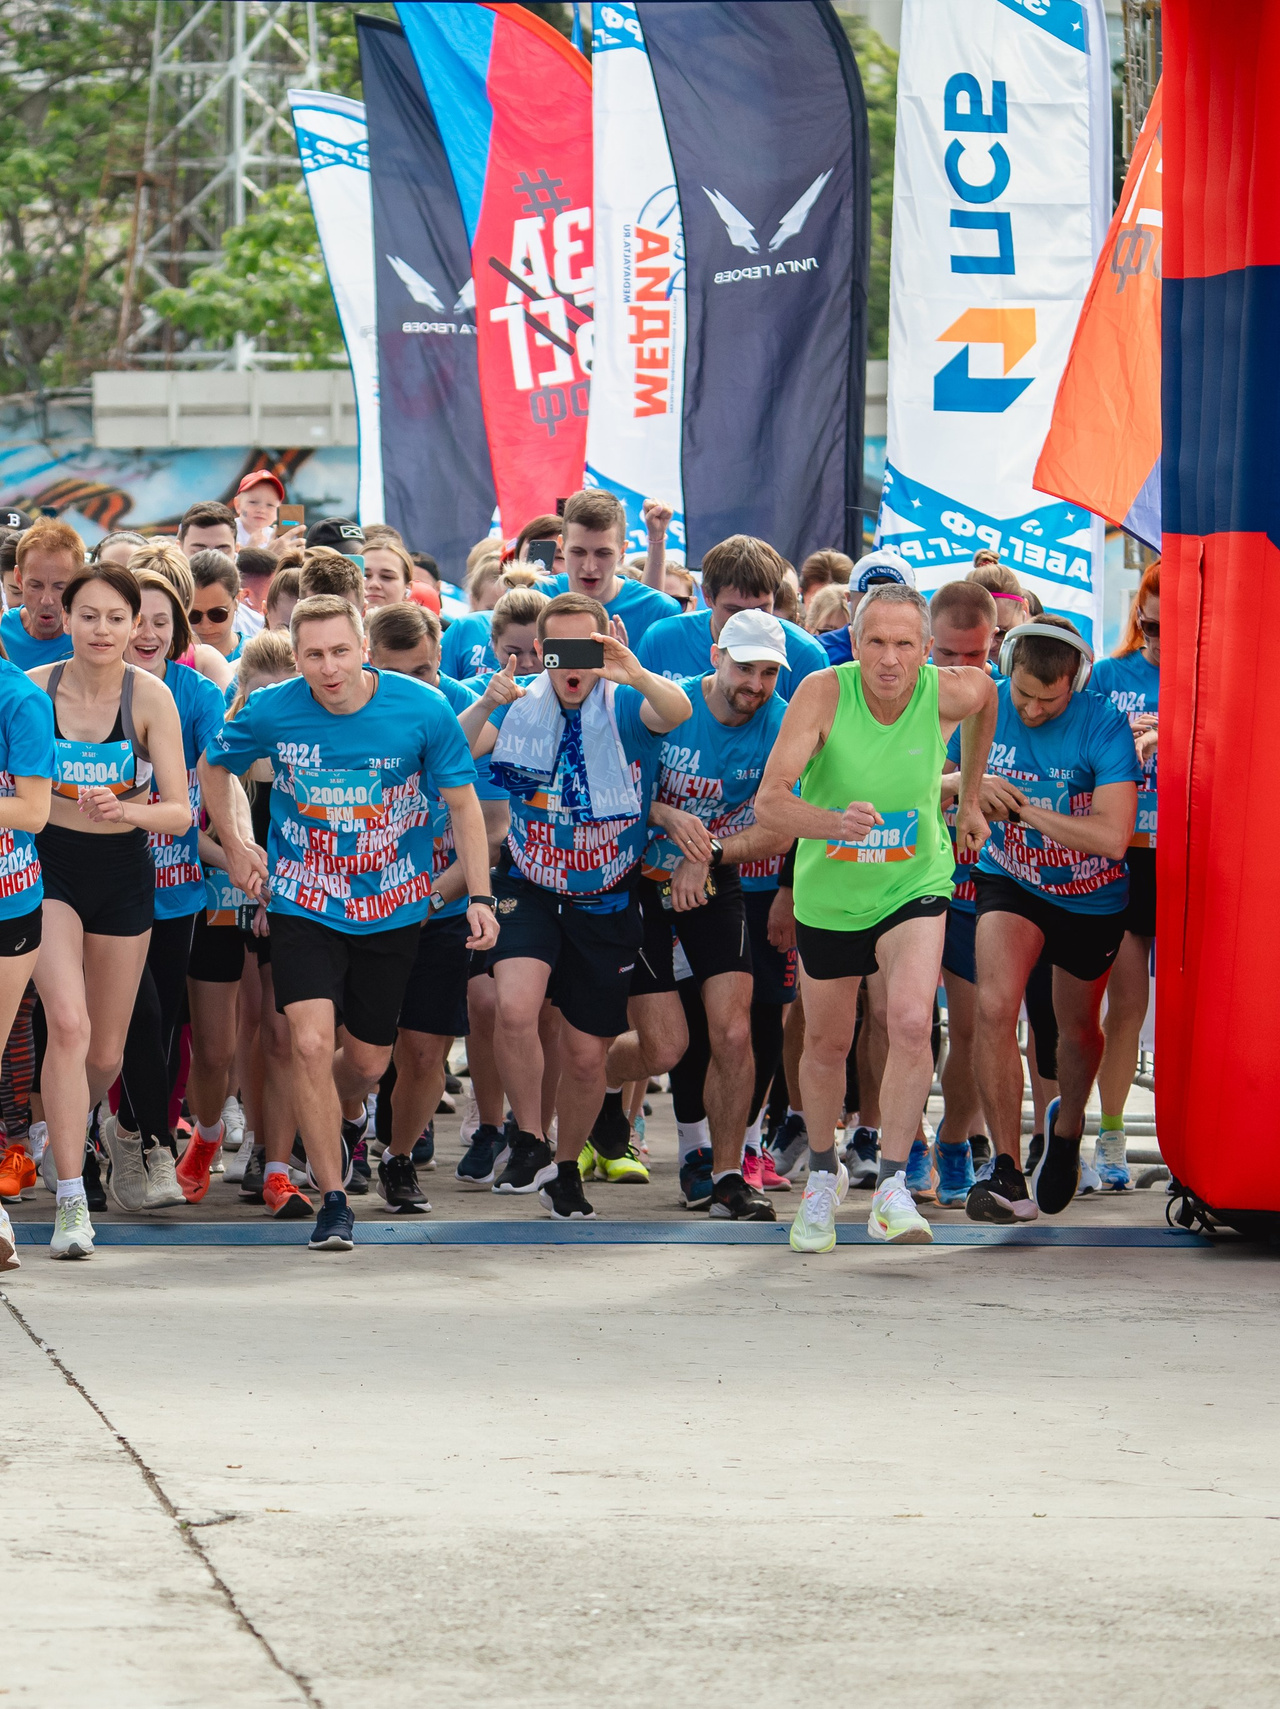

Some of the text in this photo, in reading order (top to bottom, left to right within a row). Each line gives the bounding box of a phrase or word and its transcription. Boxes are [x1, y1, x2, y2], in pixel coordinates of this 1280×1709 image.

[7, 513, 21, 527] B
[1110, 690, 1146, 712] 2024
[277, 741, 323, 768] 2024
[659, 741, 701, 774] 2024
[987, 742, 1017, 768] 024
[62, 760, 119, 783] 20304
[310, 786, 367, 806] 20040
[326, 807, 355, 821] 5KM
[281, 817, 338, 855] #ЗАБЕГ
[154, 843, 191, 868] 2024
[601, 844, 635, 887] 2024
[857, 848, 886, 863] 5KM
[380, 852, 416, 892] 2024
[1071, 856, 1109, 881] 2024
[344, 871, 432, 922] #ЕДИНСТВО
